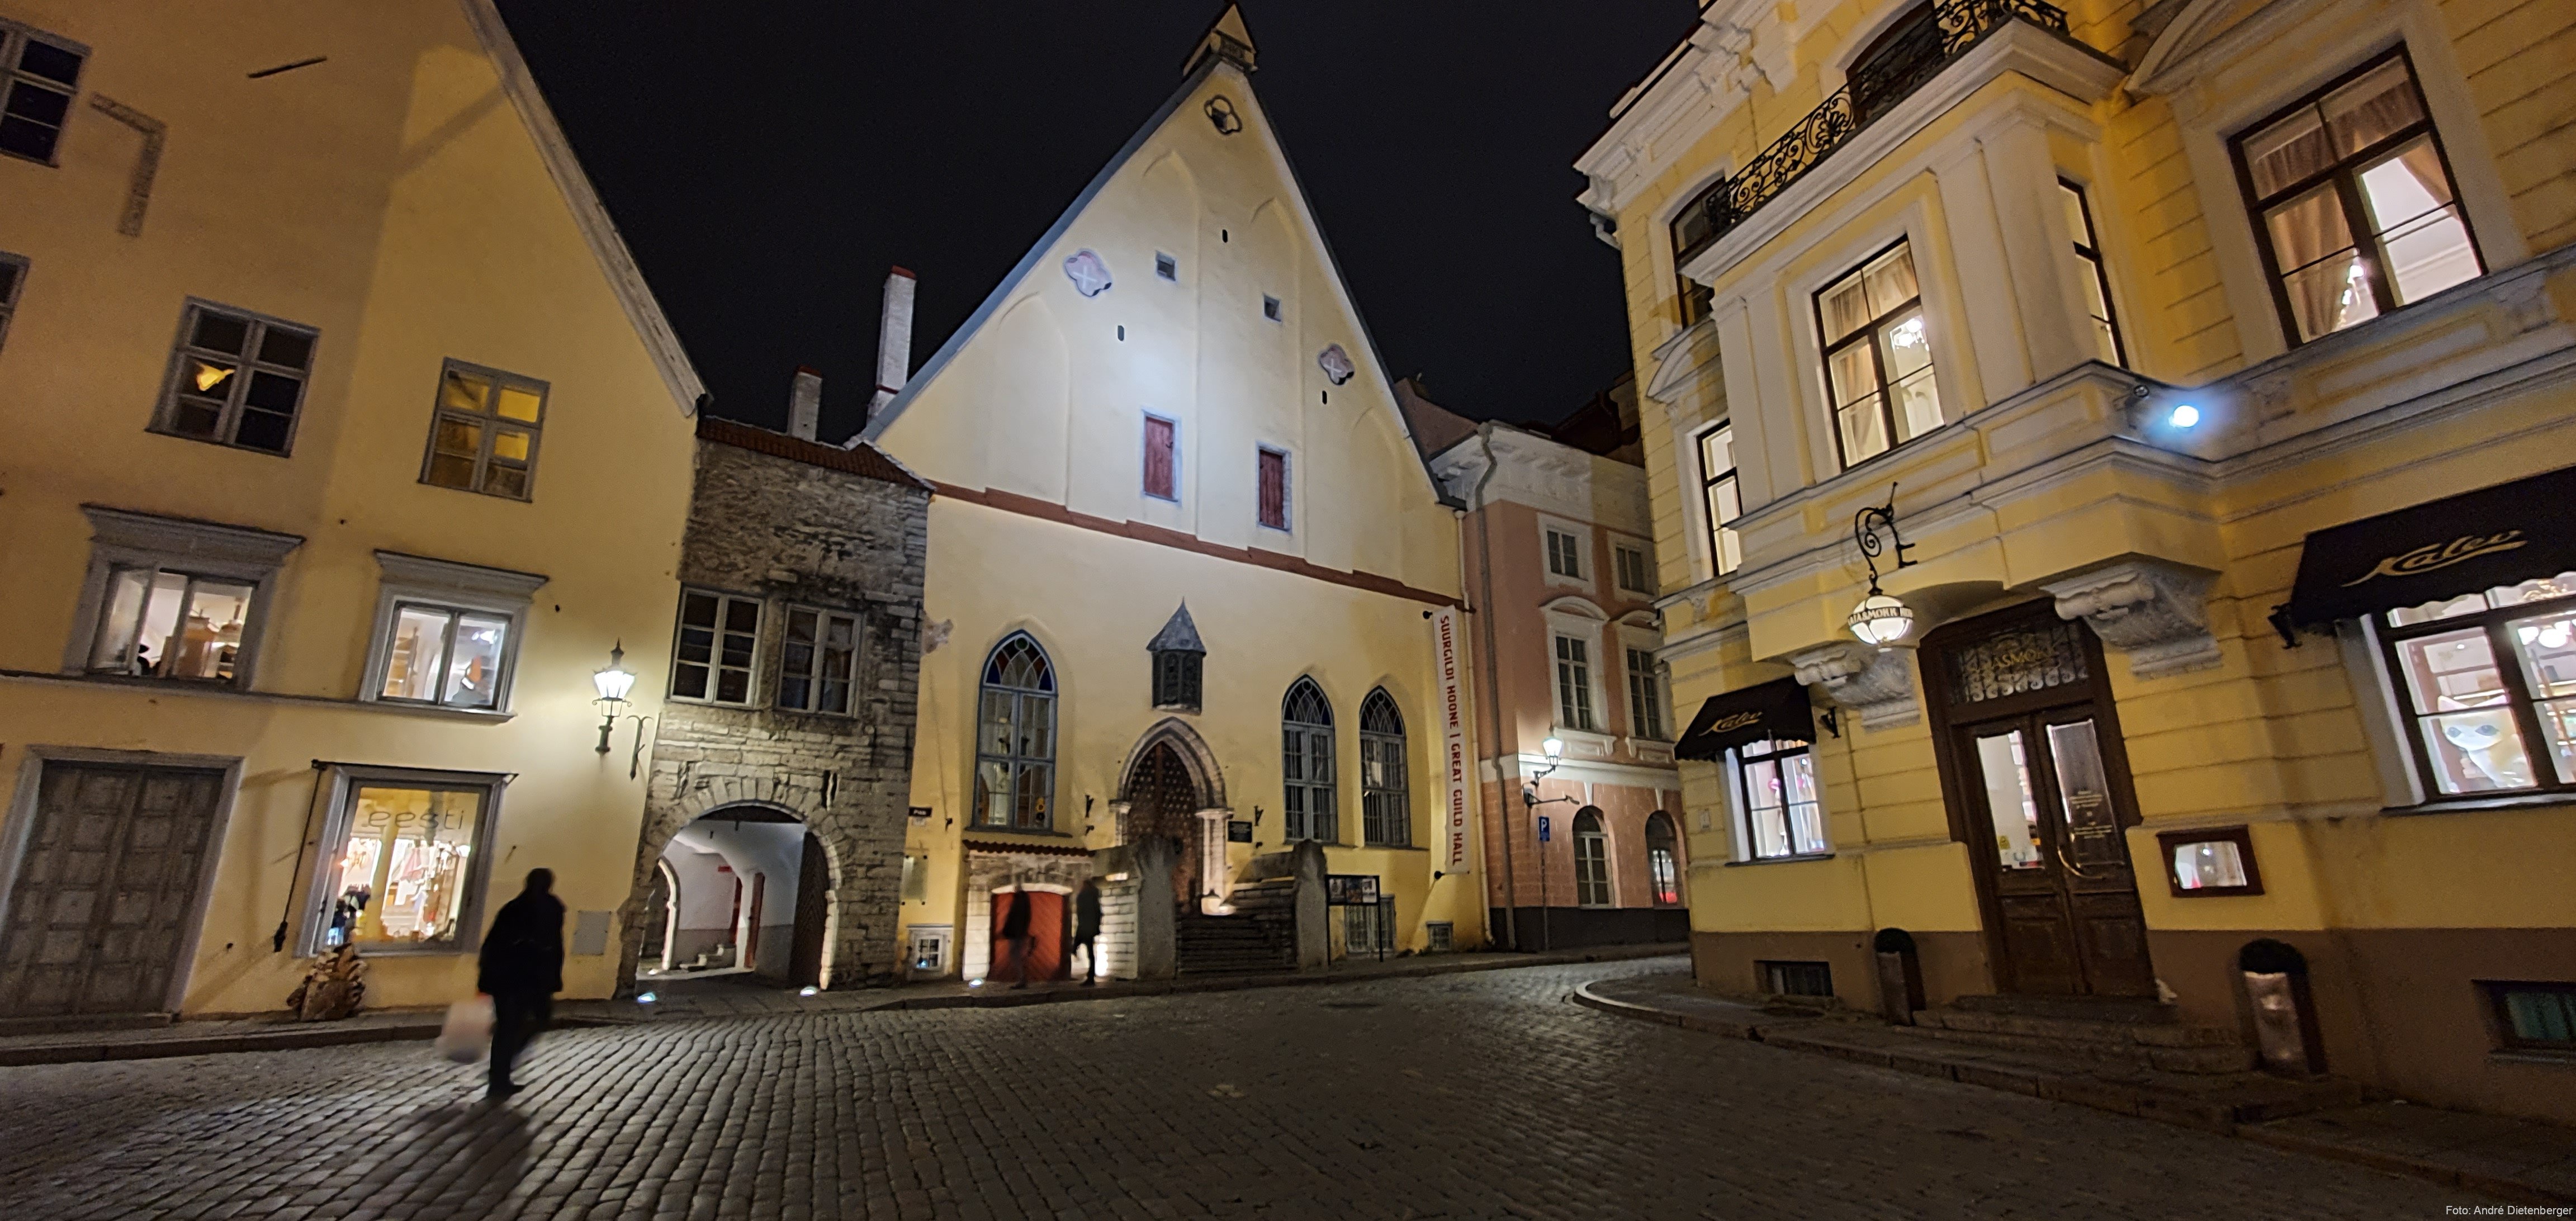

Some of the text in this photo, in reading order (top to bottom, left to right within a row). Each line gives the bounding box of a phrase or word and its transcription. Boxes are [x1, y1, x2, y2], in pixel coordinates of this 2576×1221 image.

[2341, 530, 2528, 587] Kalev
[1441, 615, 1455, 680] SUURGILDI
[1447, 685, 1459, 730] HOONE
[1698, 711, 1763, 736] Kalev
[1451, 743, 1462, 783] GREAT
[368, 809, 465, 830] eesti
[1453, 789, 1462, 827] GUILD
[1541, 818, 1547, 831] P
[1452, 832, 1462, 867] HALL
